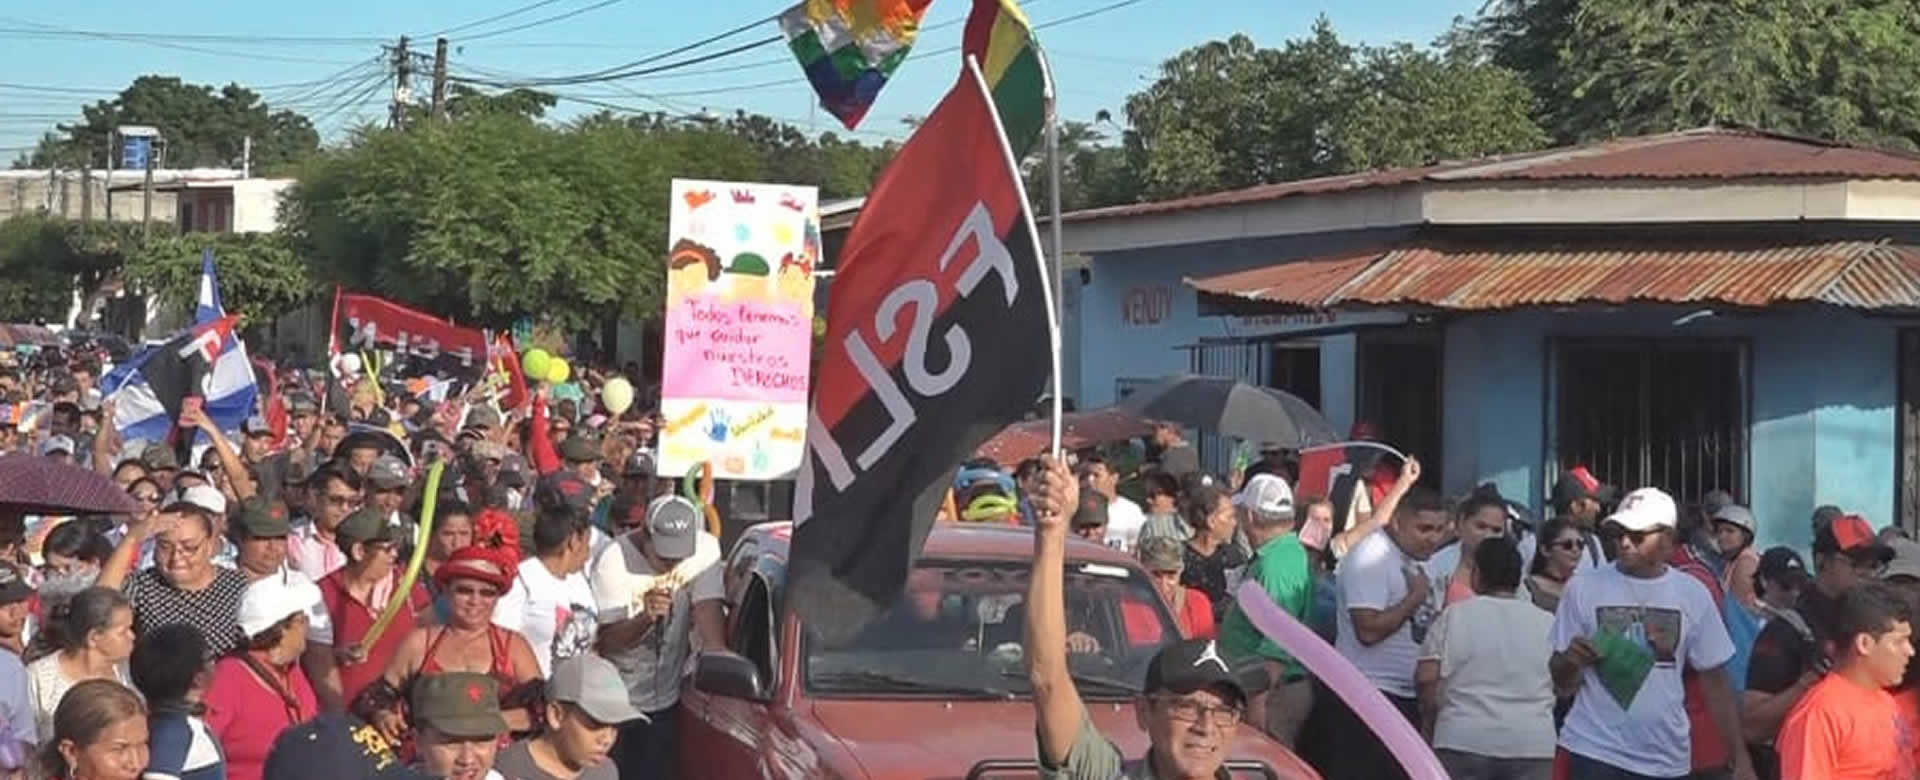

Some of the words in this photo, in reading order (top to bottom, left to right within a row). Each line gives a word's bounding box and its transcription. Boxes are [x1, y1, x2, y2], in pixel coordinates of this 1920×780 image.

[685, 298, 731, 325] Todos
[739, 304, 800, 326] tenemos
[675, 328, 701, 344] que
[703, 348, 788, 367] nuestros
[730, 367, 806, 390] DERECHOS
